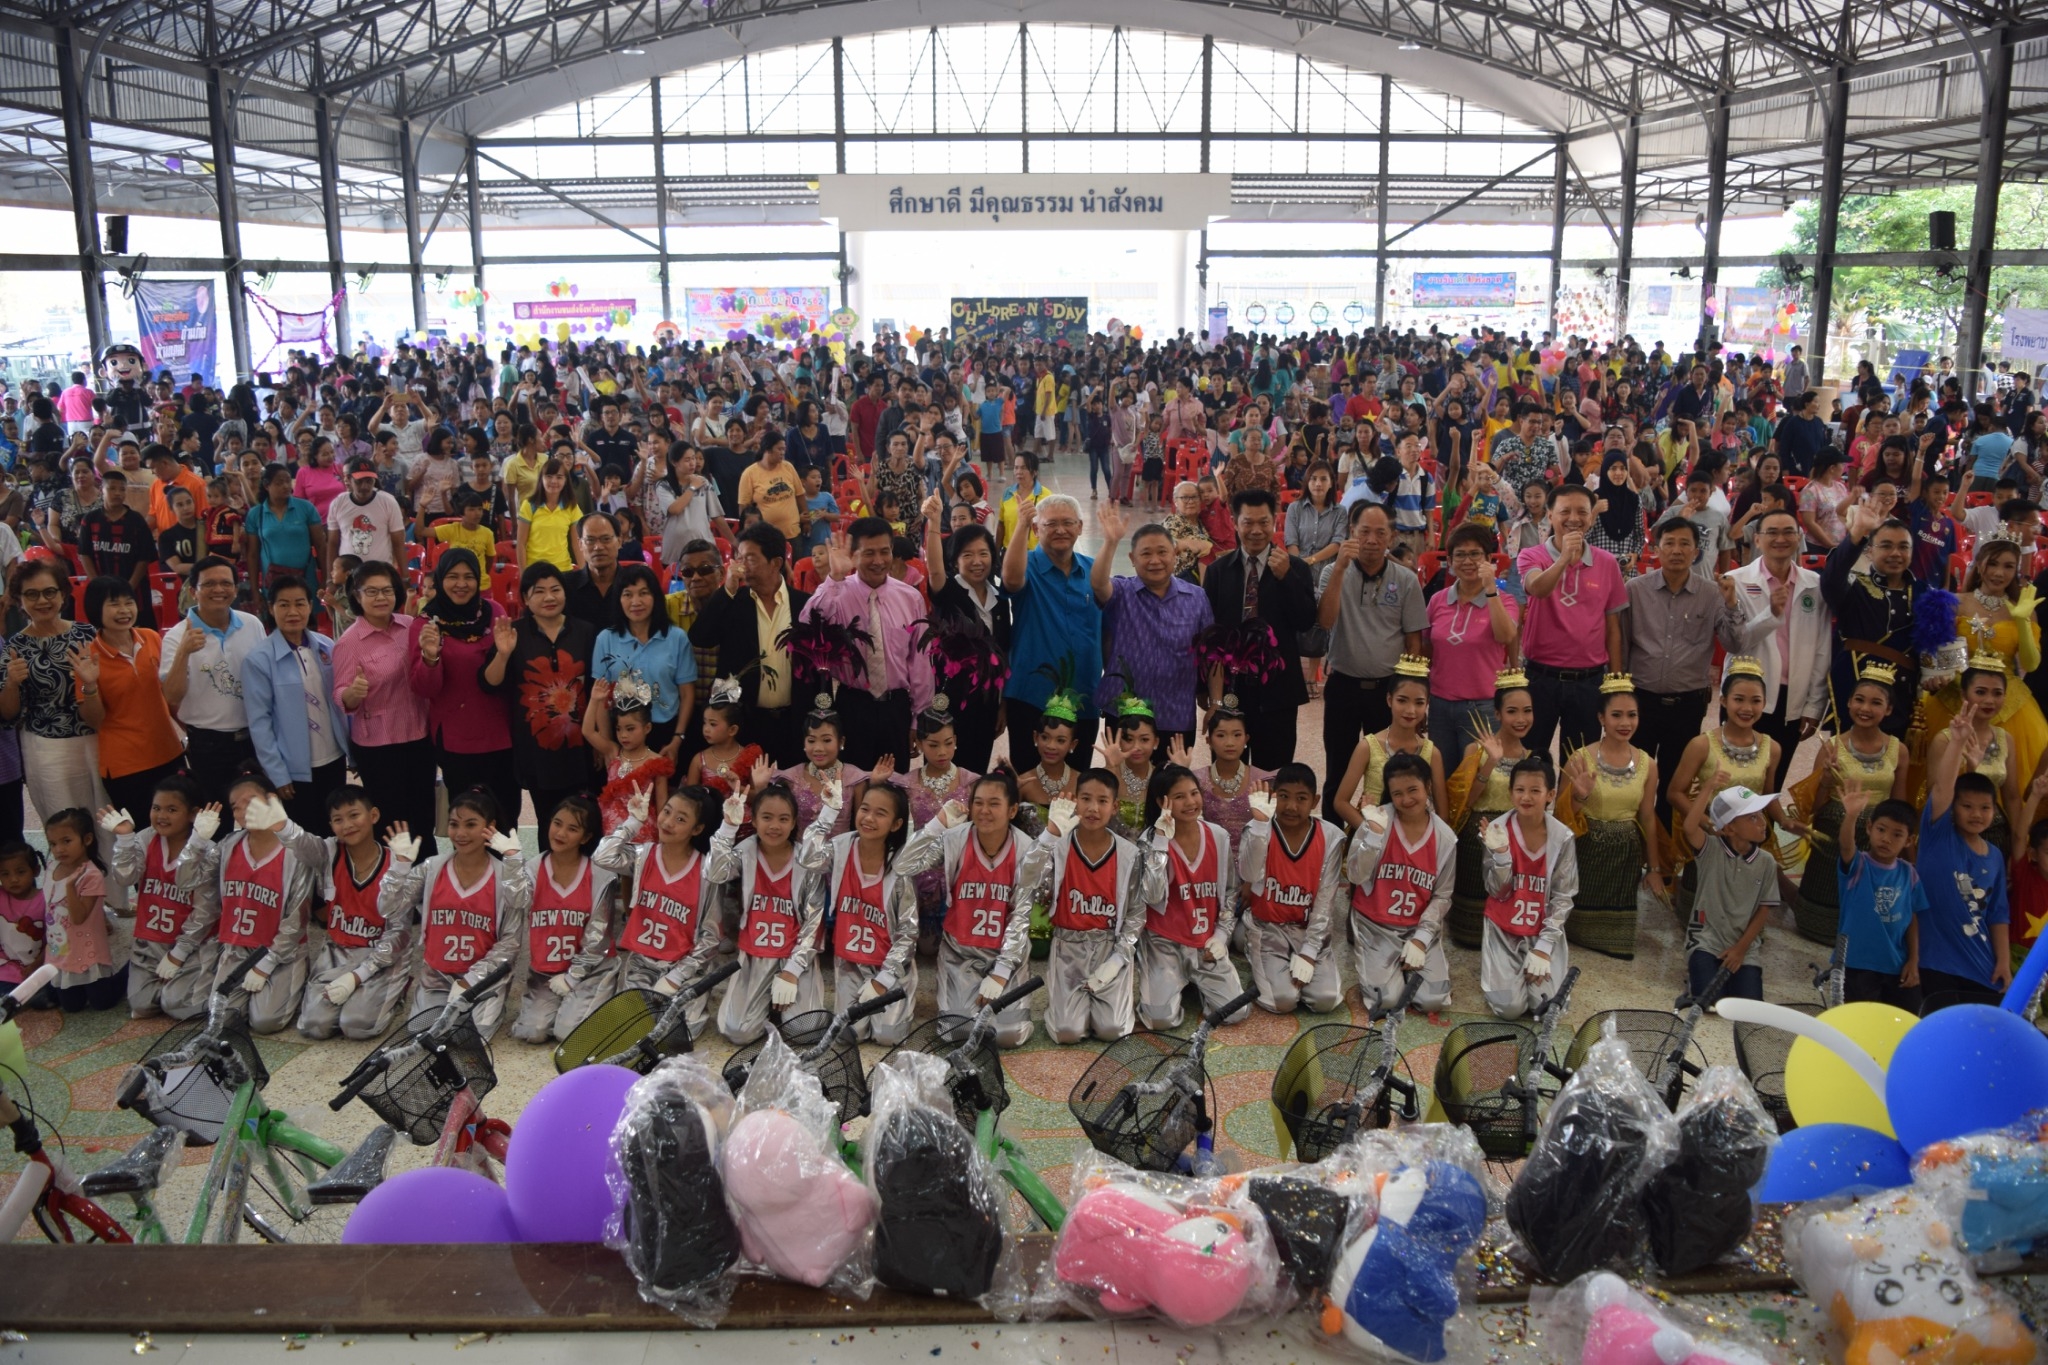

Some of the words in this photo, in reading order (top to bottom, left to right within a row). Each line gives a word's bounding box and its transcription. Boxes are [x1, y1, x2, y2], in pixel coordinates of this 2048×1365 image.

[889, 186, 961, 214] ศึกษาดี
[969, 186, 1073, 222] มีคุณธรรม
[1080, 187, 1164, 214] นำสังคม
[1053, 303, 1086, 324] DAY
[1917, 529, 1946, 548] Rakuten
[143, 879, 162, 895] EW
[1377, 863, 1406, 880] NEW
[1407, 866, 1436, 891] YORK
[246, 882, 280, 908] YORK
[752, 894, 768, 911] EW
[771, 895, 794, 916] YOR
[958, 882, 987, 899] NEW
[990, 883, 1010, 902] YOR
[1069, 889, 1116, 917] Phillie
[1267, 877, 1312, 906] Phillie
[1388, 889, 1417, 917] 25
[146, 905, 175, 933] 25
[531, 909, 559, 928] NEW
[560, 910, 590, 928] YOR
[637, 890, 659, 910] EW
[659, 896, 691, 924] YORK
[1510, 899, 1540, 926] 25
[232, 907, 258, 936] 25
[431, 909, 457, 925] NEW
[460, 911, 492, 933] YORK
[637, 918, 668, 950] 25
[972, 909, 1002, 938] 25
[444, 935, 475, 961] 25
[546, 935, 576, 962] 25
[755, 922, 785, 948] 25
[845, 925, 876, 954] 25
